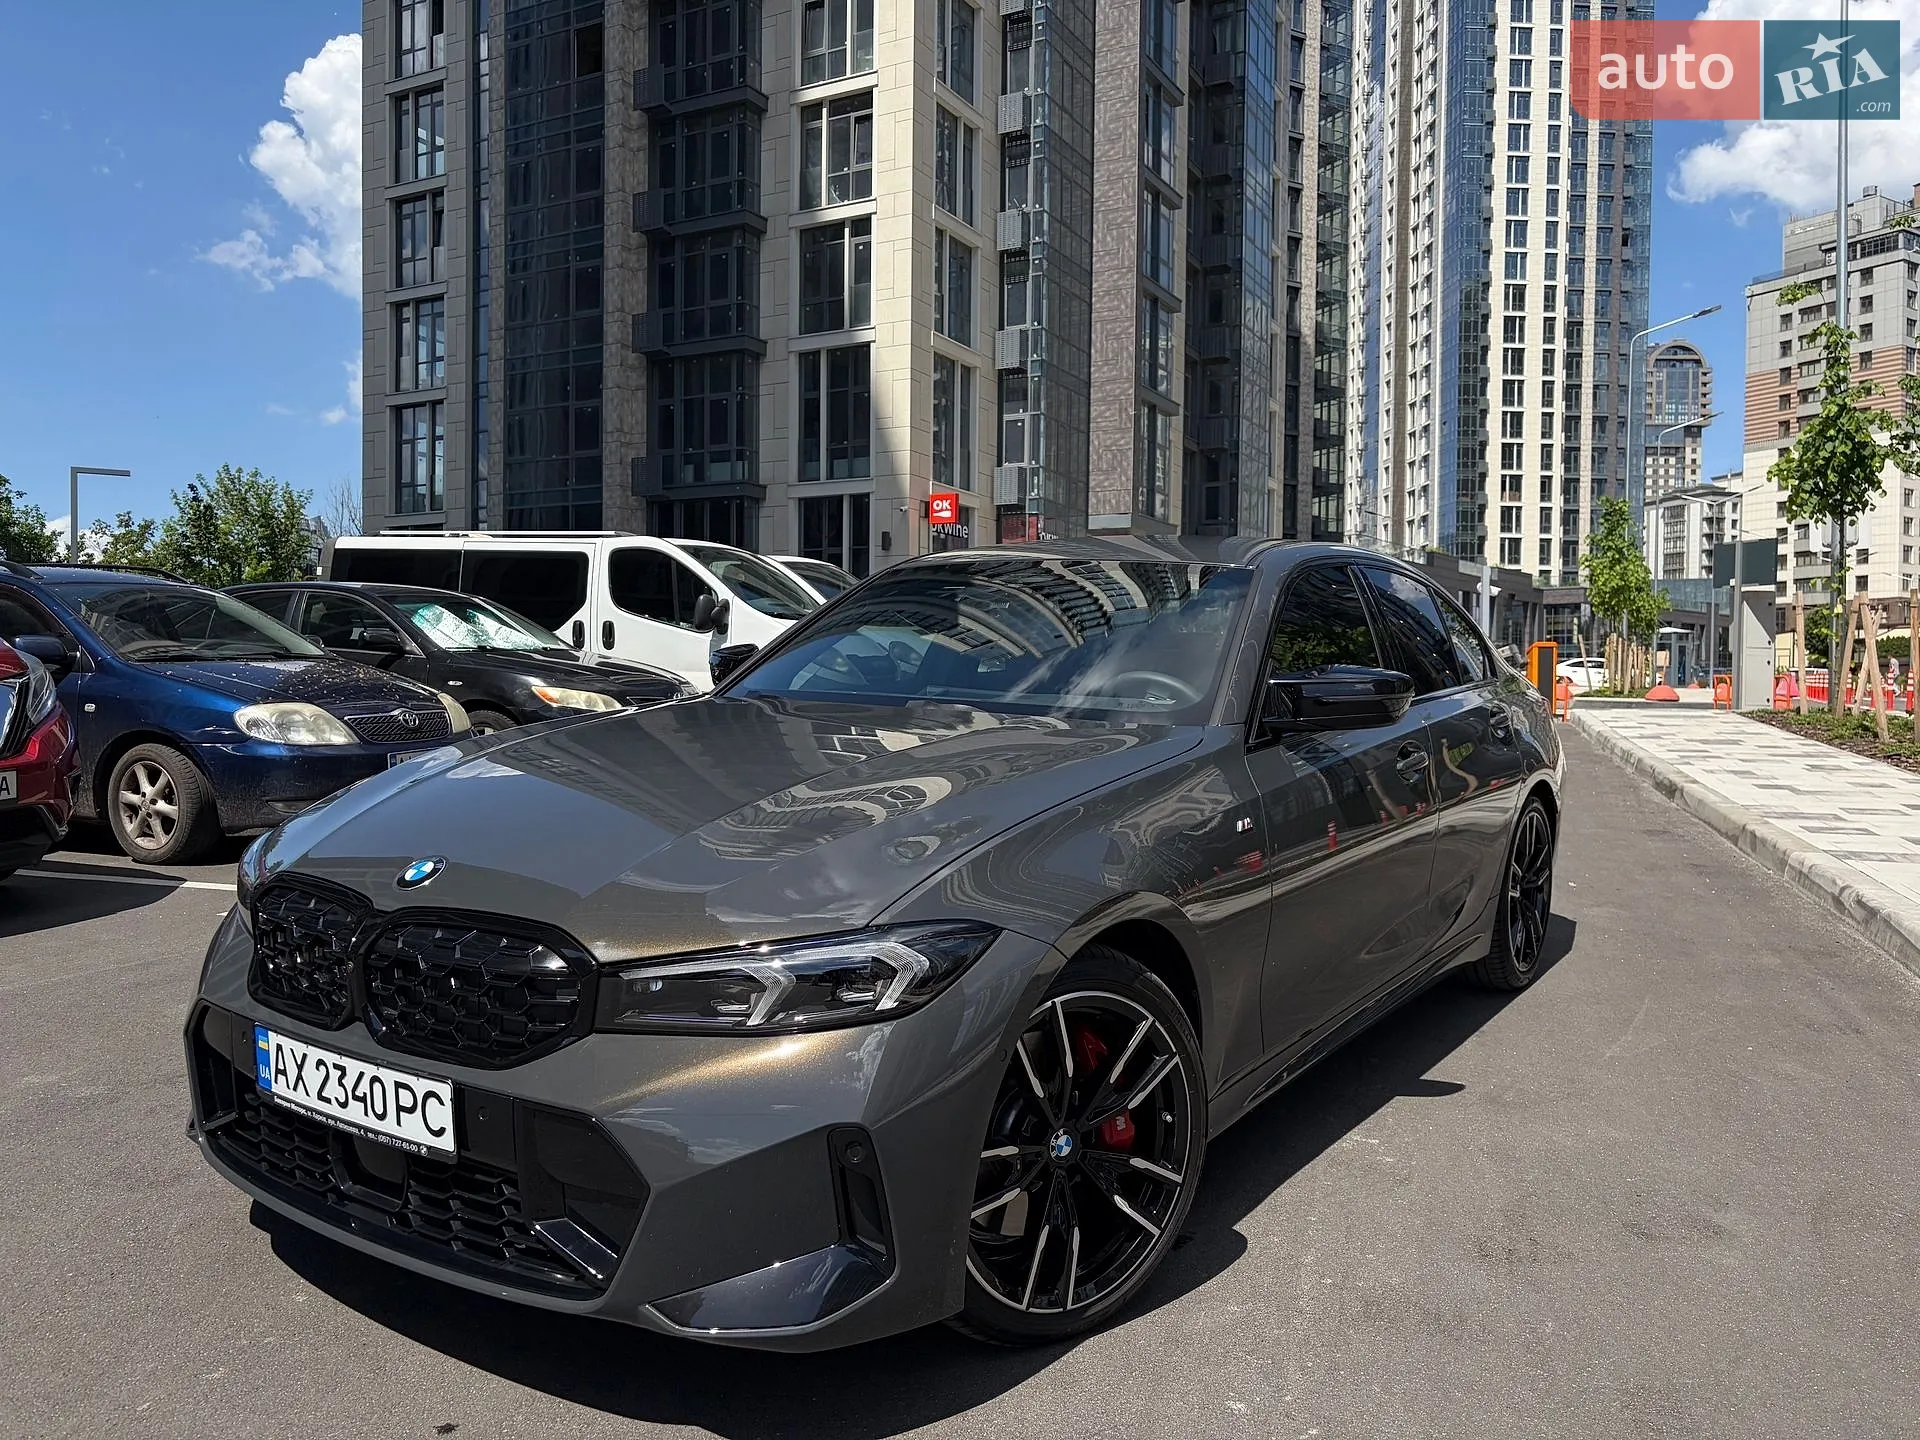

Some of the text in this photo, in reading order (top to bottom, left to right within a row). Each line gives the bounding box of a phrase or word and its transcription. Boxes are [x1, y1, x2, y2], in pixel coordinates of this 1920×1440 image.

[932, 499, 952, 511] OK
[259, 1066, 271, 1081] UA
[274, 1042, 447, 1138] AX 2340 PC
